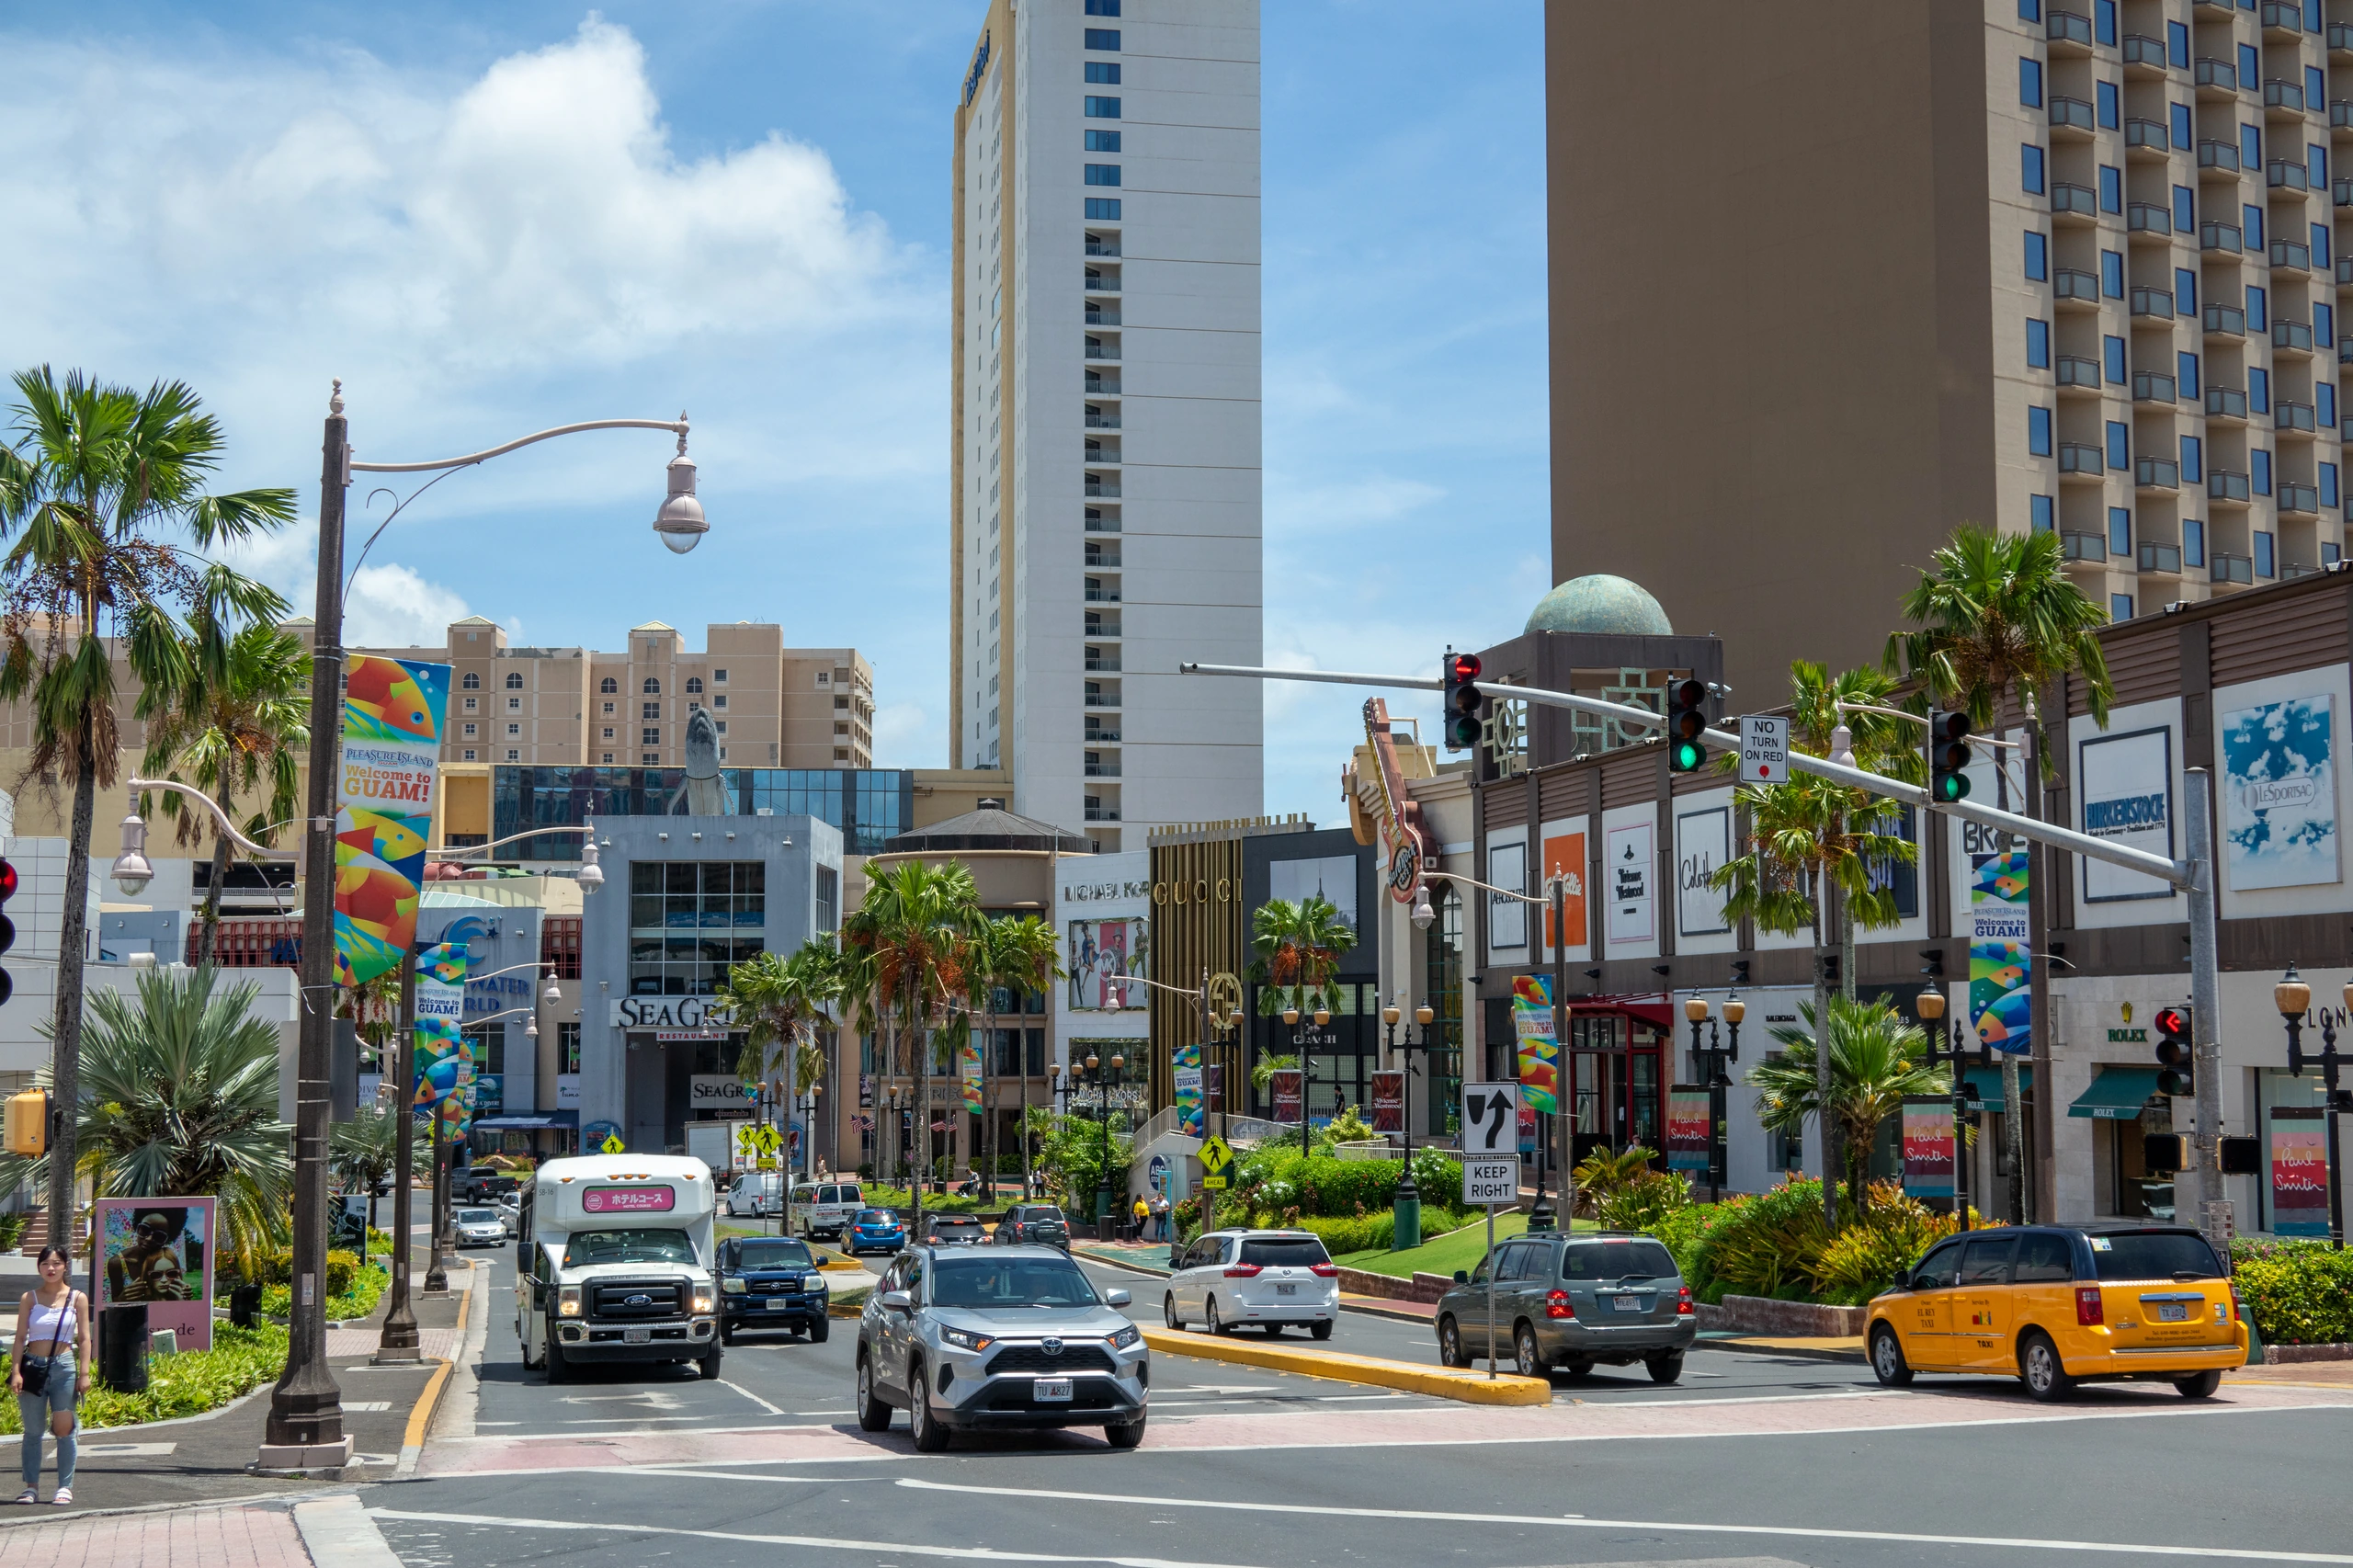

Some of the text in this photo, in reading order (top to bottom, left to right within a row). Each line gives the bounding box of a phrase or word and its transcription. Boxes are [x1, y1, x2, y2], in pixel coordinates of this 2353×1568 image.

[1755, 721, 1775, 733] NO
[1751, 736, 1779, 747] TURN
[346, 748, 434, 767] PLEASURE ISLAND
[1745, 749, 1783, 762] ON RED
[346, 765, 431, 783] Welcome to
[344, 778, 429, 802] GUAM!
[2086, 792, 2165, 830] BIRKENSTOCK
[1065, 881, 1149, 902] MICHAEL KOR
[1154, 878, 1244, 905] GUCCI
[1975, 926, 2026, 937] GUAM!
[467, 972, 530, 995] WATER
[418, 1004, 459, 1015] GUAM!
[464, 997, 500, 1011] RLD
[1518, 1026, 1553, 1034] GUAM!
[2108, 1028, 2148, 1042] ROLEX
[1078, 1090, 1138, 1102] MICHAL KORS
[1967, 1101, 1985, 1109] ROLEX
[1676, 1111, 1701, 1124] Paul
[2094, 1108, 2115, 1117] ROLEX
[1670, 1128, 1707, 1140] Smith
[1914, 1127, 1945, 1142] Paul
[1907, 1147, 1951, 1162] Smith
[2281, 1147, 2315, 1167] Paul
[1474, 1166, 1507, 1179] KEEP
[2276, 1174, 2325, 1192] Smith
[1472, 1184, 1510, 1197] RIGHT
[611, 1194, 663, 1205] ホテルコース
[1977, 1340, 1994, 1348] TAXI
[1038, 1385, 1071, 1397] TU 4827
